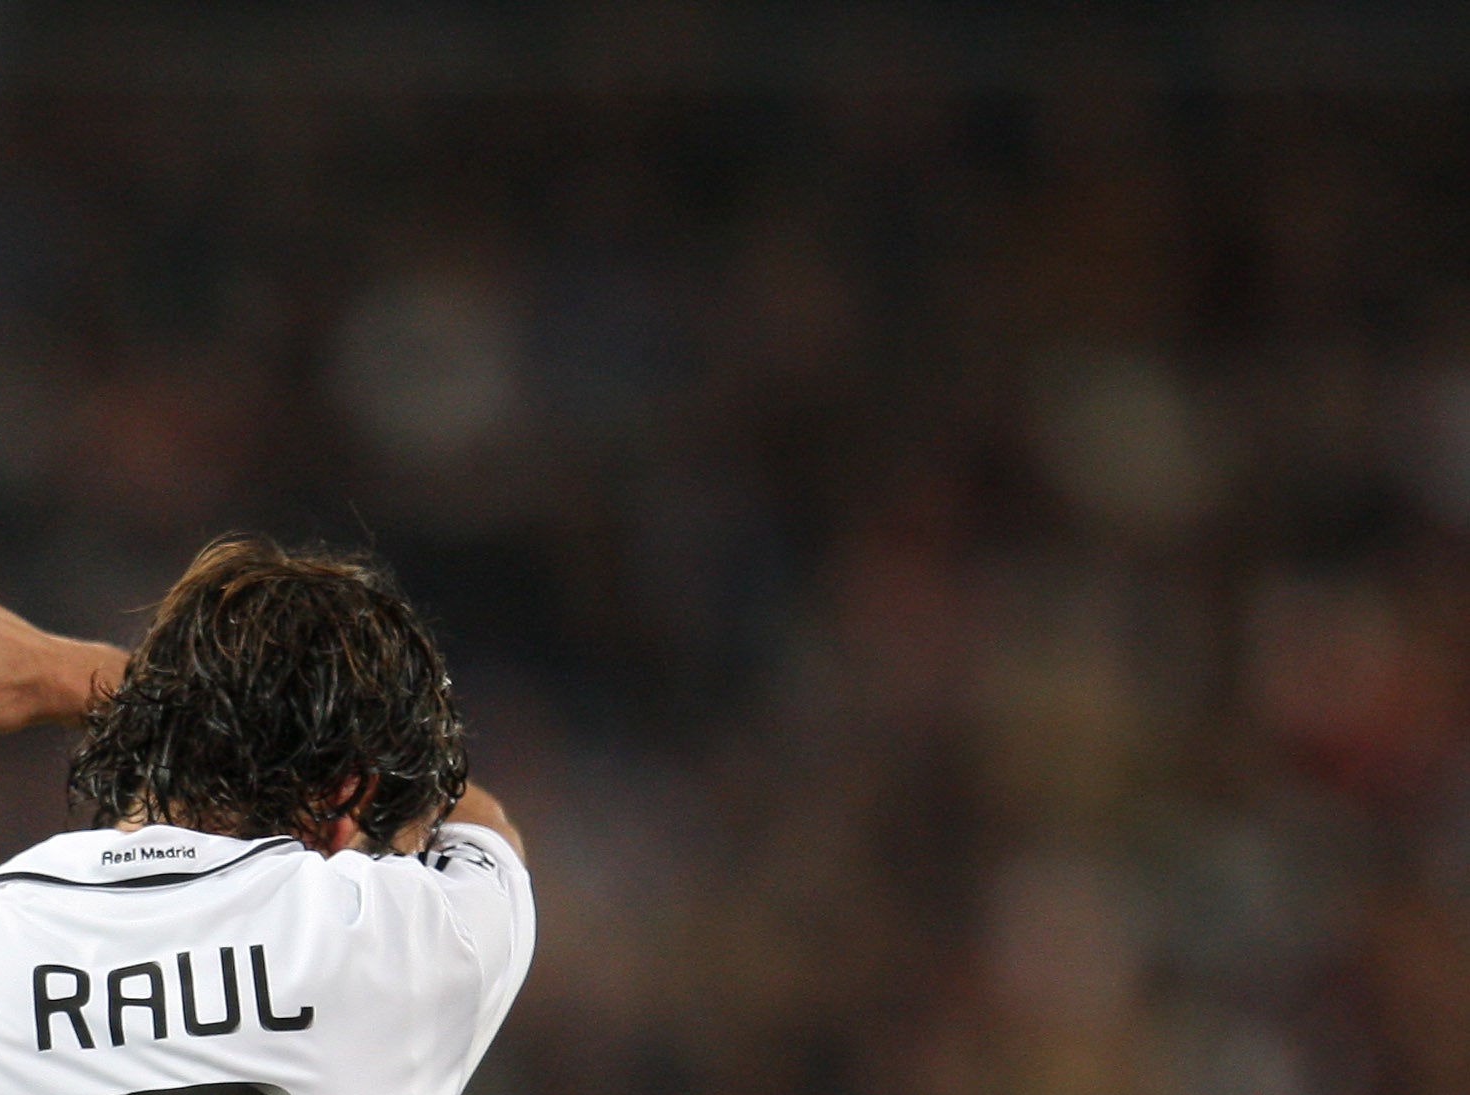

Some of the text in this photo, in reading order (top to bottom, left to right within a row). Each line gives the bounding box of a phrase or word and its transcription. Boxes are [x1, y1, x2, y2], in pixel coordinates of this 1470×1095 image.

[100, 846, 196, 866] Real Madrid
[33, 944, 314, 1052] RAUL
